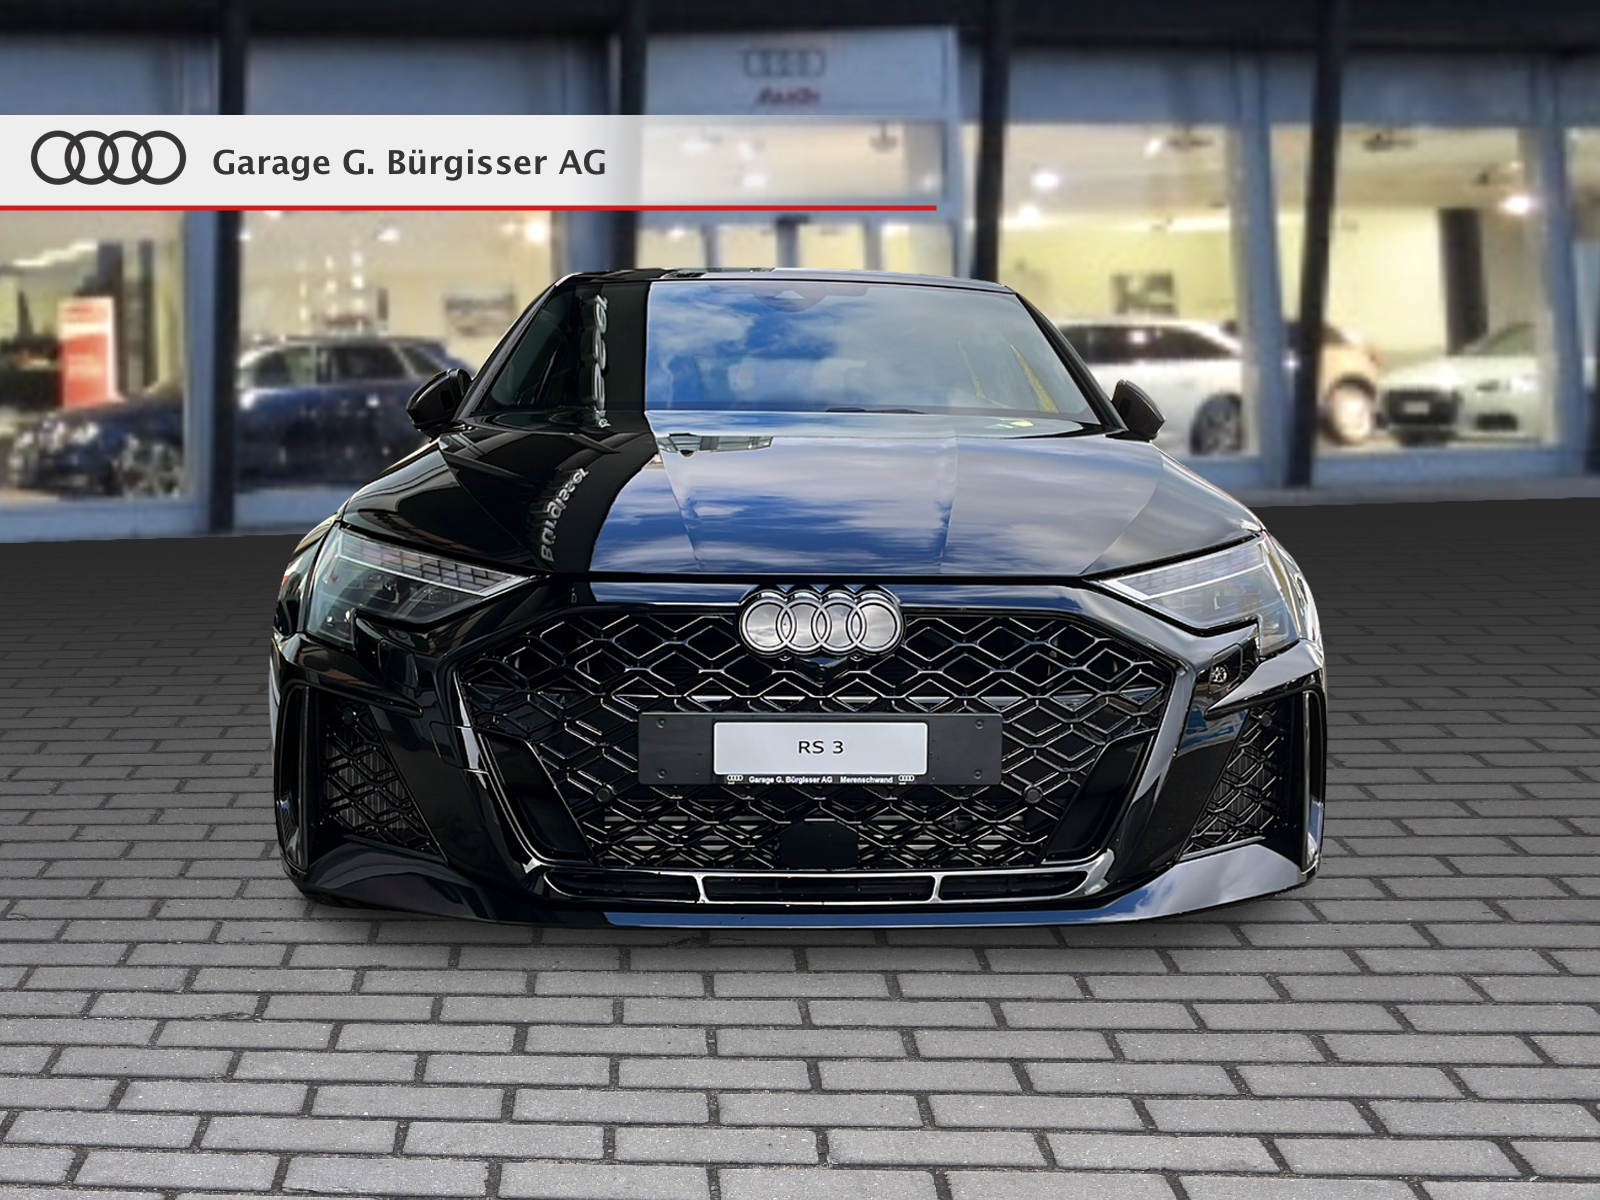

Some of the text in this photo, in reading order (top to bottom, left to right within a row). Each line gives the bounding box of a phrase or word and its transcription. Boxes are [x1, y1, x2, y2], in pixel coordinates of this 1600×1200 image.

[798, 740, 844, 754] RS 3
[748, 775, 775, 785] Garage
[776, 775, 785, 784] G.
[785, 775, 820, 785] Bürgisser
[821, 775, 833, 784] AG
[839, 775, 894, 784] Merenschwand
